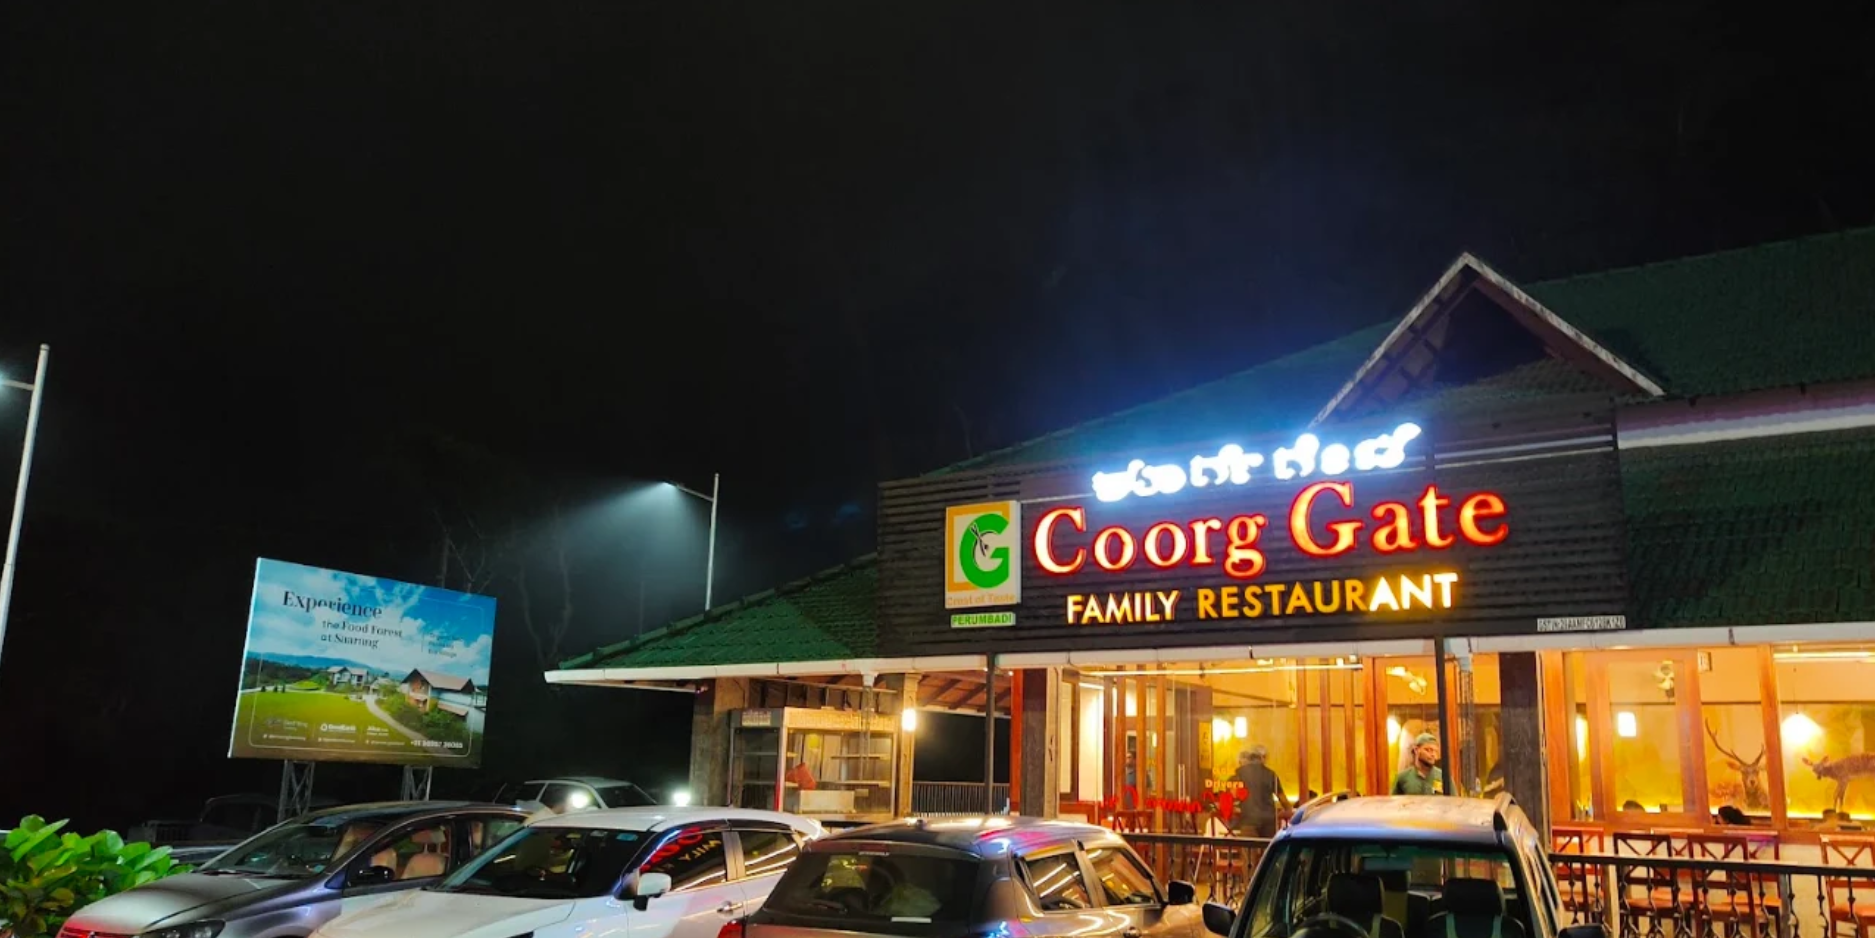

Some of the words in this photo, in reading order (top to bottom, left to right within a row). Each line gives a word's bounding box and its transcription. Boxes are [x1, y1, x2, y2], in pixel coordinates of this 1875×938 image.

[1033, 506, 1268, 579] Coorg
[1290, 482, 1510, 557] Gate
[282, 590, 382, 618] Experience
[1067, 589, 1179, 624] FAMILY
[1198, 572, 1459, 618] RESTAURANT
[322, 620, 339, 630] the
[341, 621, 369, 633] Food
[371, 624, 403, 638] Forest
[952, 613, 1012, 625] PERUMBADI
[320, 634, 332, 642] at
